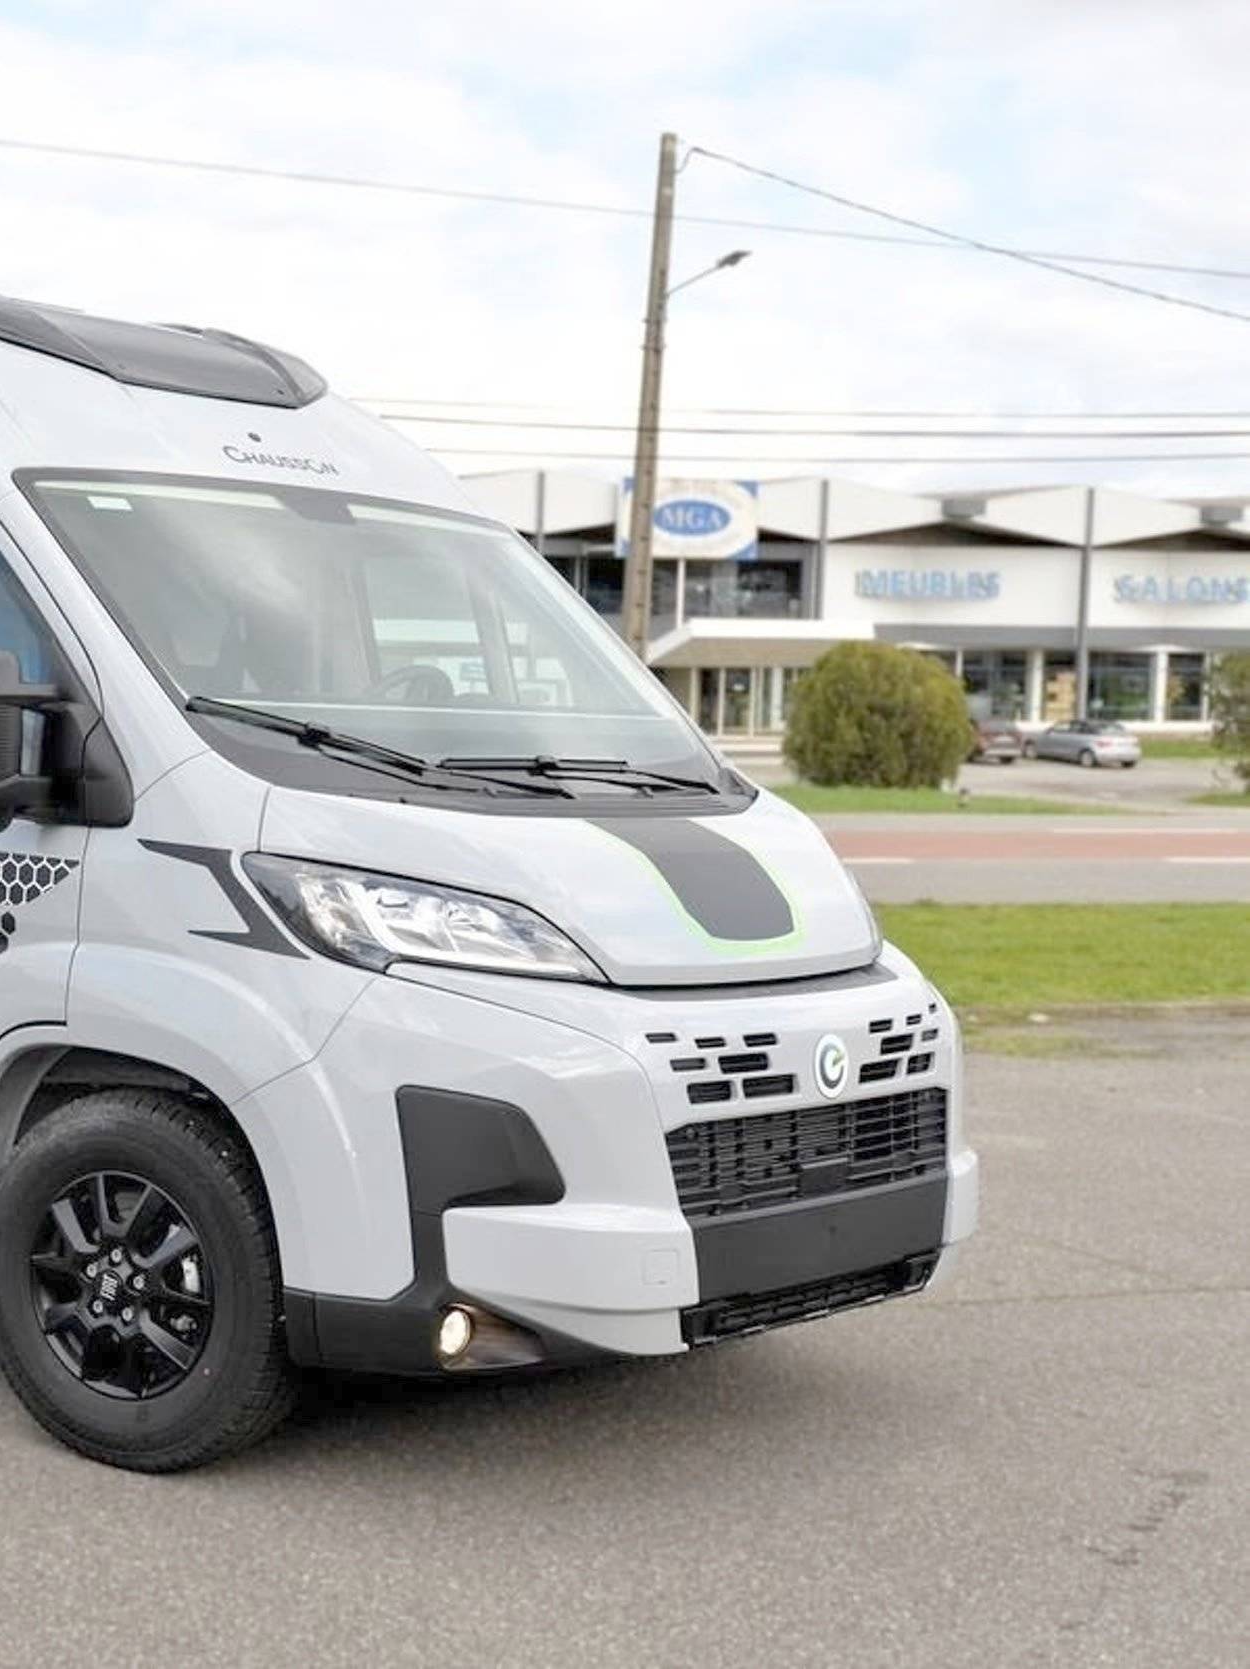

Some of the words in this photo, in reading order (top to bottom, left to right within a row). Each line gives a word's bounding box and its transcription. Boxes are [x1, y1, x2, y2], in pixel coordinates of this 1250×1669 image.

[222, 445, 340, 476] CHAUSSON
[661, 506, 724, 529] MGA
[854, 570, 1001, 600] MEUBLES
